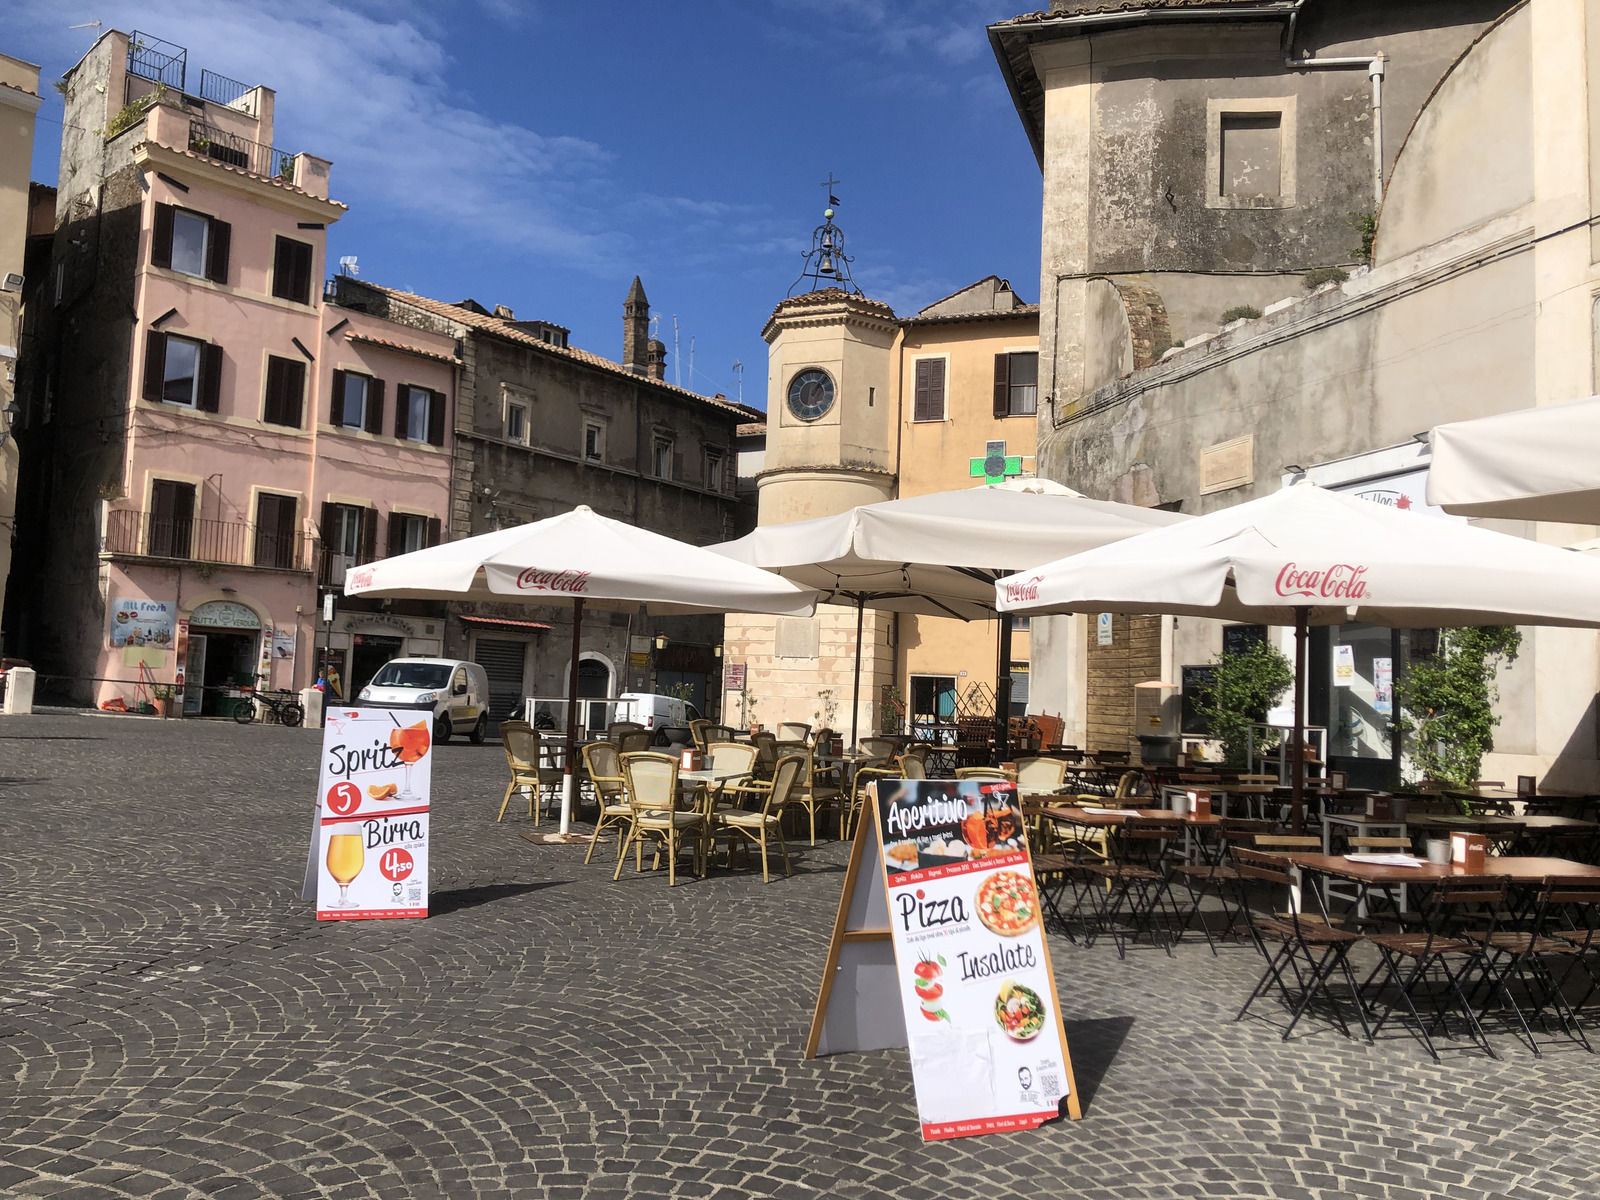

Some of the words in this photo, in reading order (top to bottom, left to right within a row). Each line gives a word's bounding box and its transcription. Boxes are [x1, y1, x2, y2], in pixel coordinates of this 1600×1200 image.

[516, 566, 592, 592] Coca-Cola
[1276, 562, 1370, 598] Coca-Cola
[190, 616, 218, 625] FRUTTA
[234, 618, 260, 628] VERDURA
[329, 738, 405, 780] Spritz
[338, 784, 352, 812] 5
[364, 817, 424, 848] Birra
[887, 794, 967, 838] Aperitivo
[385, 852, 412, 878] 4,50
[896, 890, 969, 932] Pizza
[957, 942, 1036, 982] Insalate
